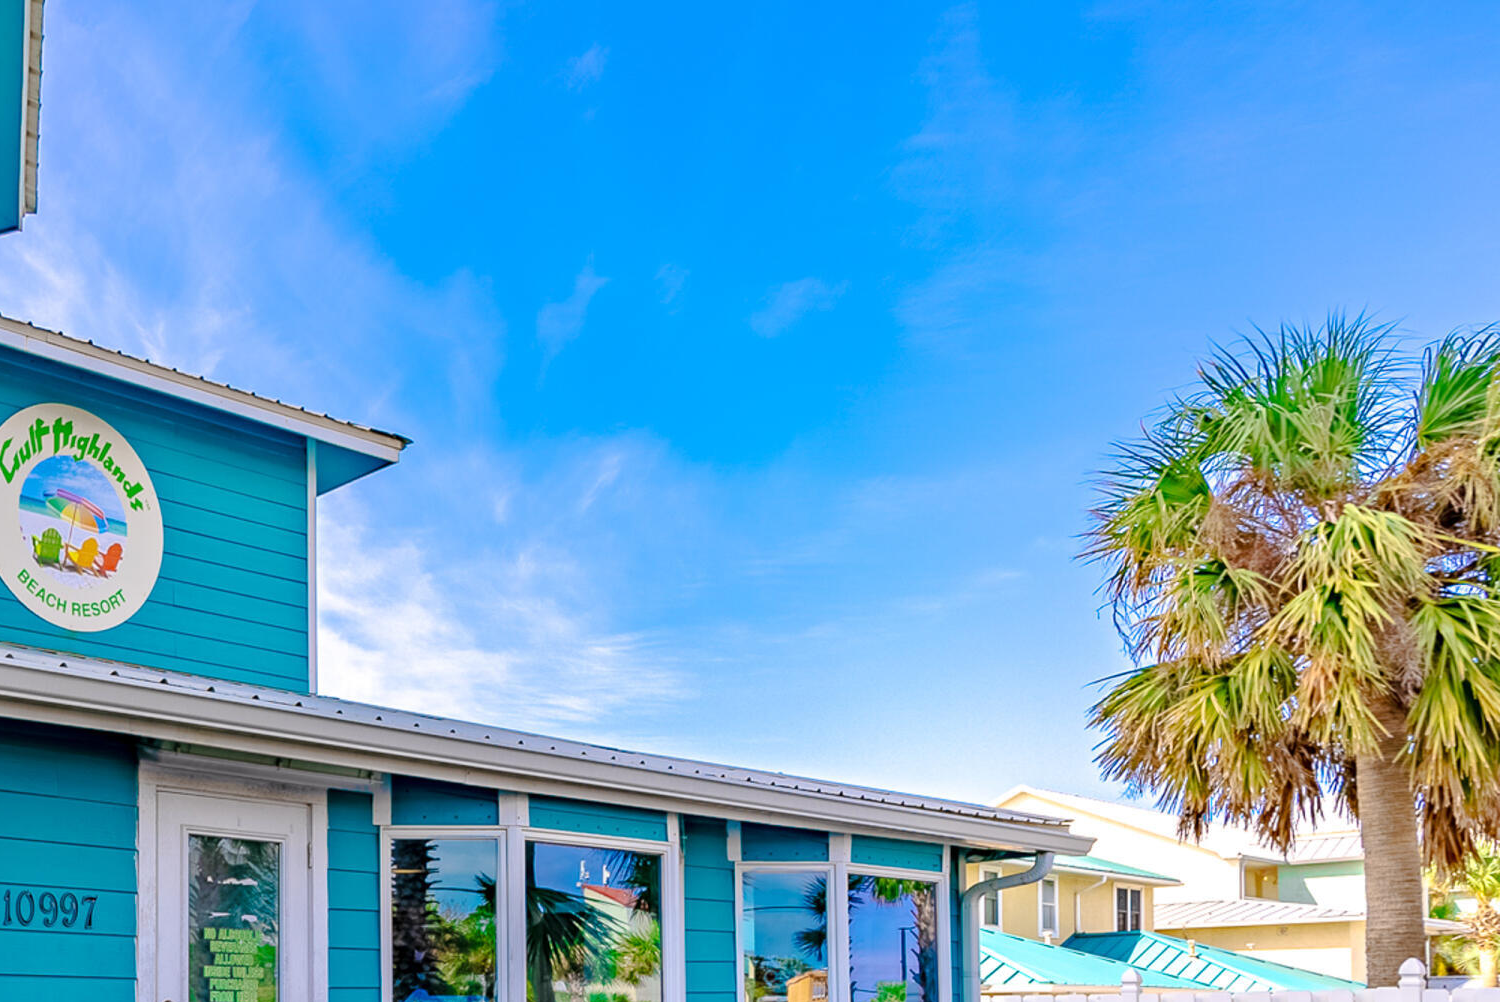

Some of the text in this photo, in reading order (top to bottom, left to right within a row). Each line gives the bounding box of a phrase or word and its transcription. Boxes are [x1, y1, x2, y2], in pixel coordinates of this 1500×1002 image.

[0, 416, 144, 512] Gulf Highlands
[17, 569, 127, 617] BEACH RESORT
[2, 888, 99, 930] 10997
